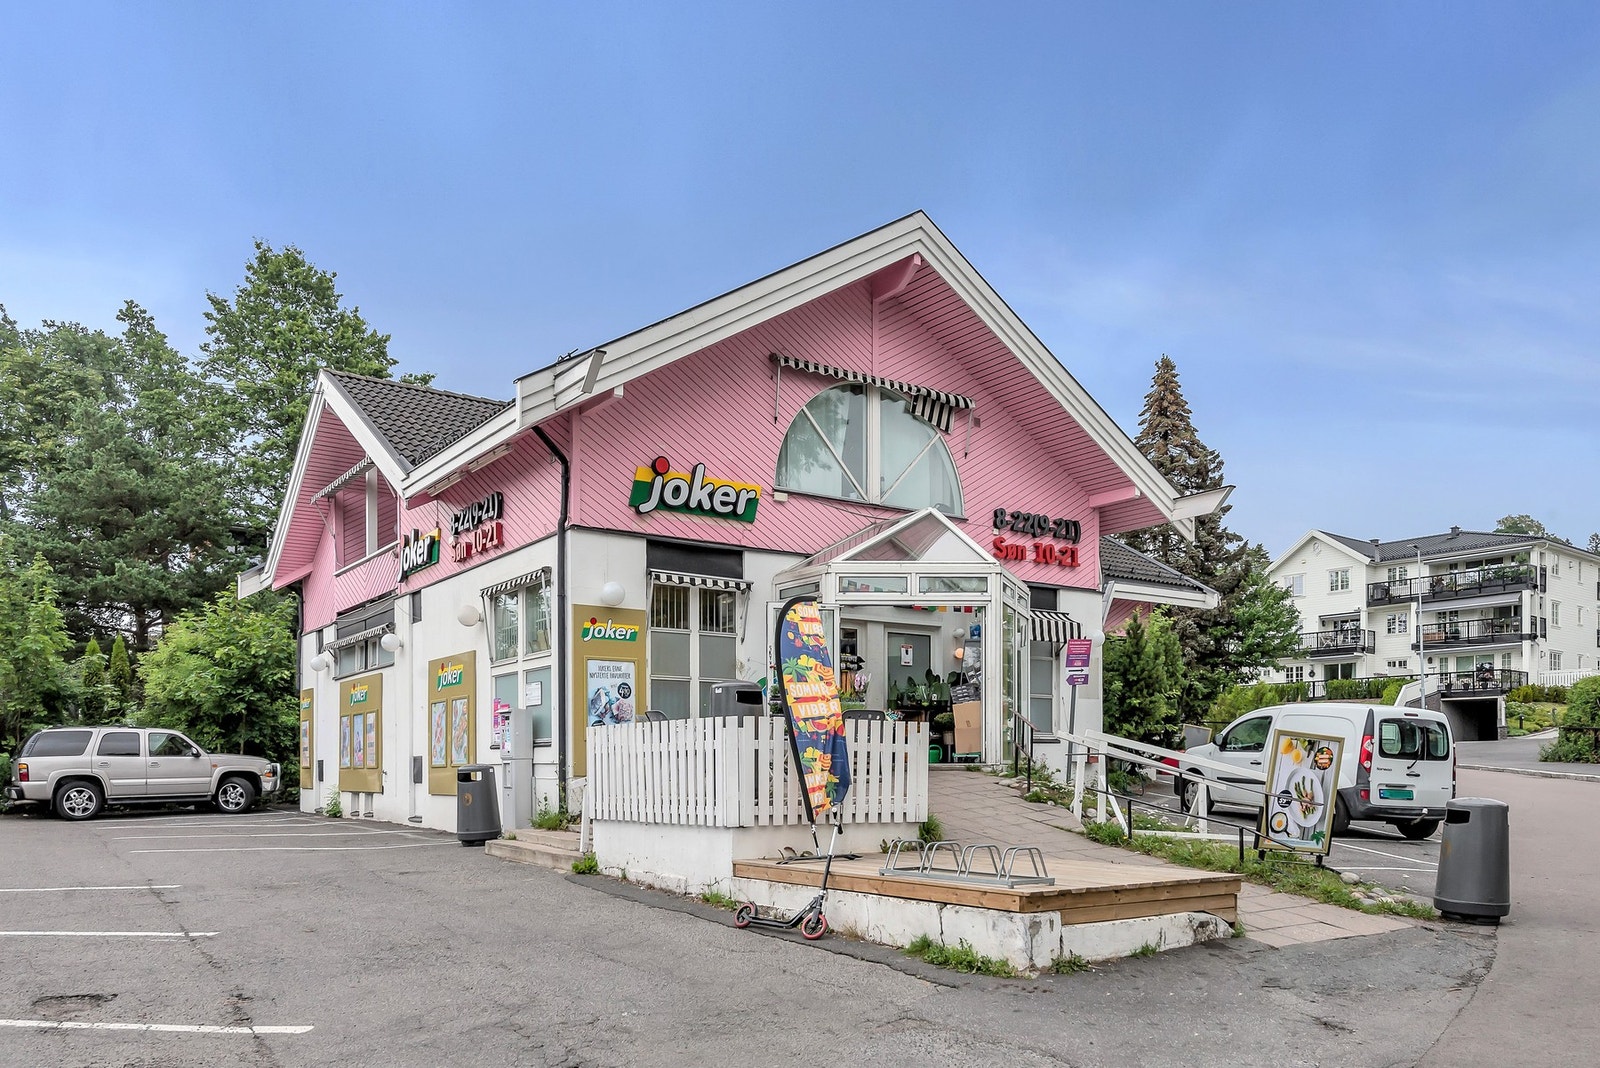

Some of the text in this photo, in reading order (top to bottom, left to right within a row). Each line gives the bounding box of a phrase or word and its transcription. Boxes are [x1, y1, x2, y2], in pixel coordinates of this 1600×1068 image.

[635, 456, 757, 516] joker
[450, 491, 503, 536] 8-22(9-21)
[993, 508, 1081, 544] 8-22(9-21)
[398, 529, 435, 583] joker
[451, 522, 504, 563] Søn 10-21
[993, 536, 1080, 567] Søn 10-21
[583, 617, 635, 642] joker
[437, 661, 462, 692] joker
